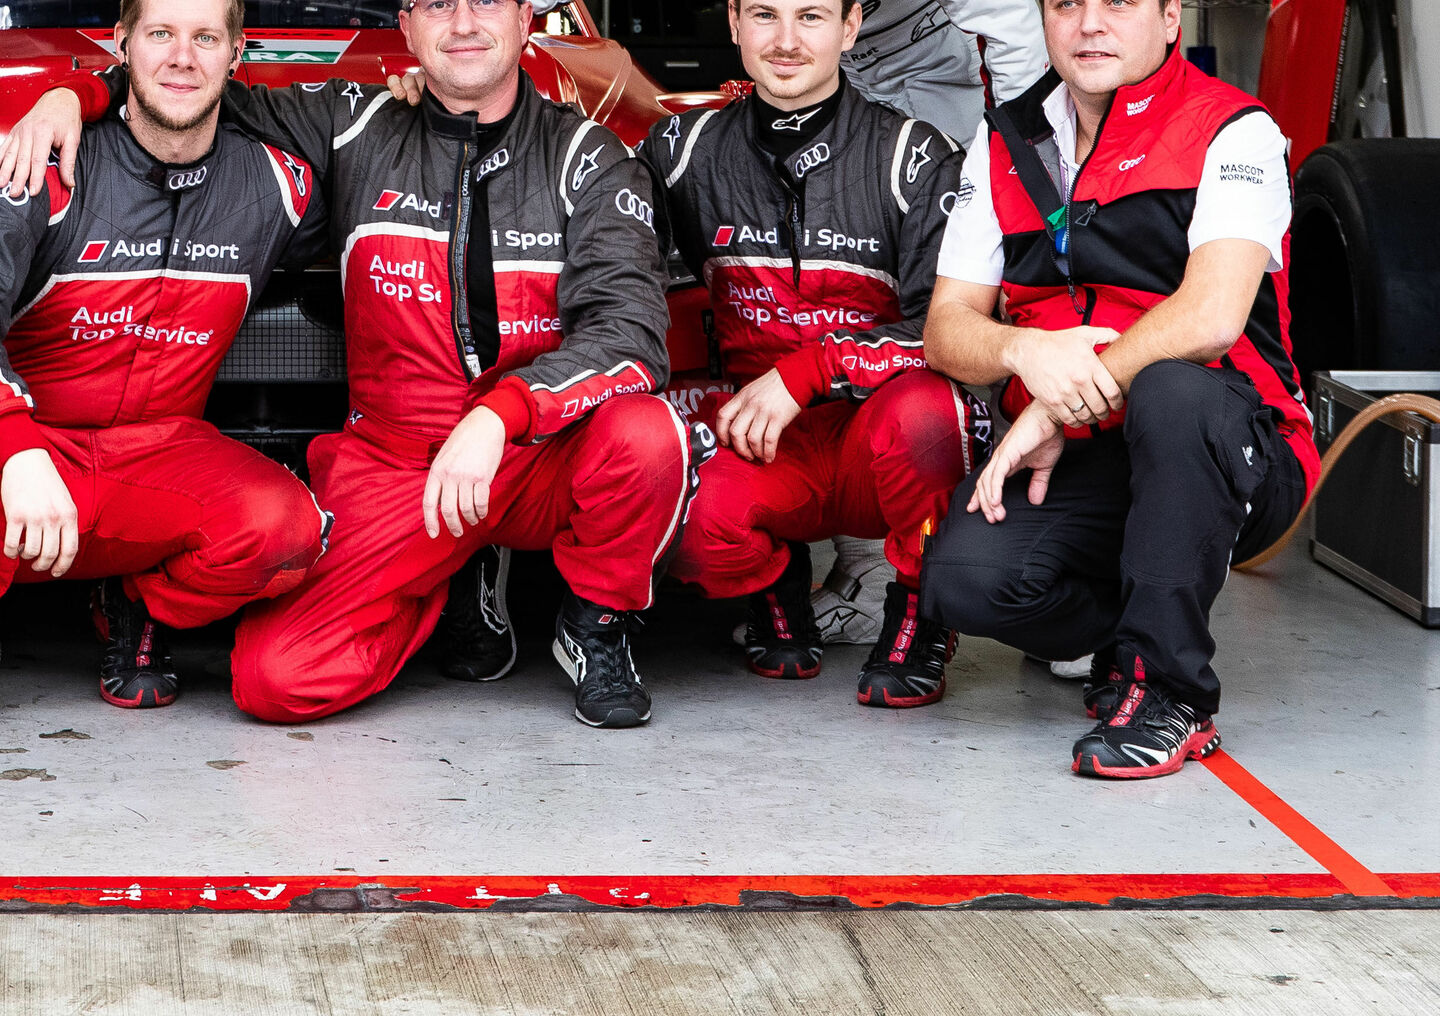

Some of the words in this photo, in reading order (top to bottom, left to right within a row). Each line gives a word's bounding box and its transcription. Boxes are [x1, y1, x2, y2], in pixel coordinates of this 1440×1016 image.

[850, 45, 880, 62] Rast
[1219, 173, 1264, 185] WORKWEAR
[184, 240, 240, 261] Sport
[504, 229, 563, 251] Spor
[816, 228, 880, 253] Sport
[369, 254, 425, 280] Audi
[369, 275, 413, 302] Top
[727, 281, 778, 304] Audi
[70, 305, 134, 325] Audi
[728, 300, 772, 327] Top
[858, 356, 889, 372] Audi
[891, 354, 928, 368] Spor
[581, 389, 613, 411] Audi
[614, 381, 646, 395] Sport
